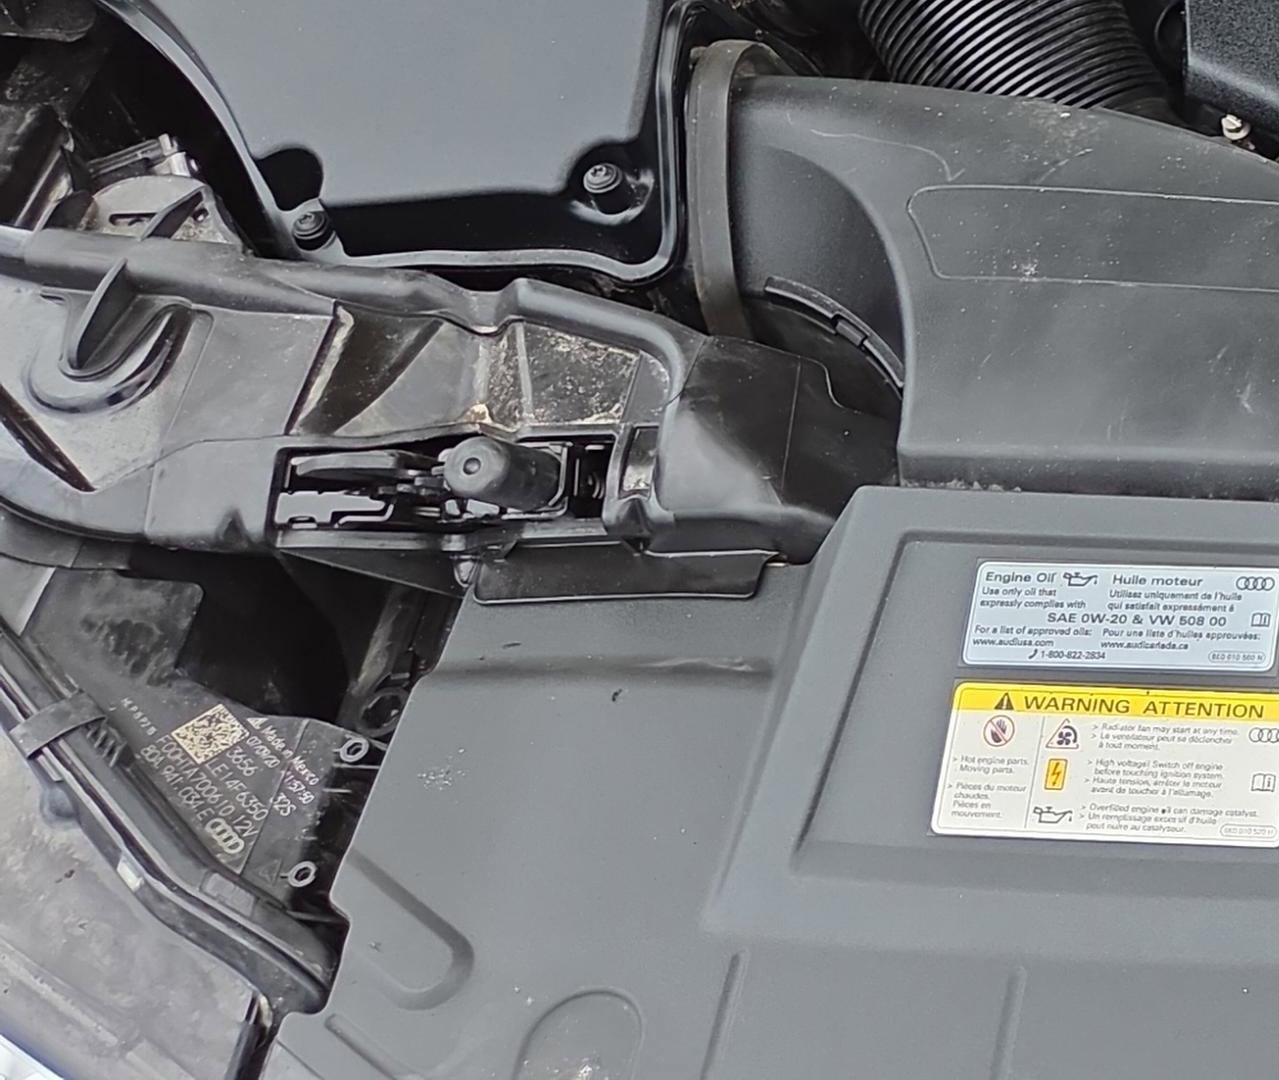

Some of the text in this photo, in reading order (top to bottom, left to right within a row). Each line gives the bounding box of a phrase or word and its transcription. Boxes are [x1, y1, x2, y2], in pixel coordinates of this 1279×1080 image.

[985, 572, 1057, 584] Engine Oil
[1112, 574, 1203, 587] Huile moteur
[982, 587, 1057, 597] Use only oil that
[1109, 590, 1243, 601] Utilisez uniquement de l'huile
[980, 600, 1086, 609] expressly complies with
[1107, 602, 1123, 611] qui
[1124, 602, 1160, 611] satisfait
[1047, 612, 1227, 627] SAE 0W-20 & VW 508 00
[974, 625, 991, 634] For
[1000, 626, 1014, 634] list
[1015, 626, 1026, 634] of
[1028, 627, 1071, 636] approved
[1102, 628, 1124, 637] Pour
[1127, 630, 1143, 638] une
[1145, 629, 1165, 638] liste
[973, 638, 1054, 647] www.audiusa.com
[1024, 695, 1265, 718] WARNING ATTENTION
[1153, 726, 1170, 734] may
[1172, 726, 1191, 734] start
[1203, 728, 1217, 736] any
[1156, 734, 1175, 743] peut
[261, 724, 286, 752] Made
[292, 755, 319, 786] Mexico
[960, 755, 975, 763] Hot
[977, 756, 1005, 766] engine
[224, 747, 257, 777] 3656
[1096, 758, 1115, 768] High
[1152, 760, 1180, 769] Switch
[1195, 763, 1223, 771] engine
[959, 765, 989, 774] Moving
[1123, 769, 1158, 778] touching
[1160, 770, 1191, 779] ignition
[204, 758, 269, 821] LE14F6350
[984, 783, 995, 791] du
[996, 784, 1026, 792] moteur
[1089, 803, 1129, 812] Overfilled
[1131, 805, 1159, 814] engine
[1173, 807, 1188, 815] can
[1190, 808, 1223, 818] damage
[1087, 812, 1100, 820] Un
[1102, 813, 1152, 824] remplissage
[1085, 822, 1105, 831] peut
[1107, 822, 1128, 831] nuire
